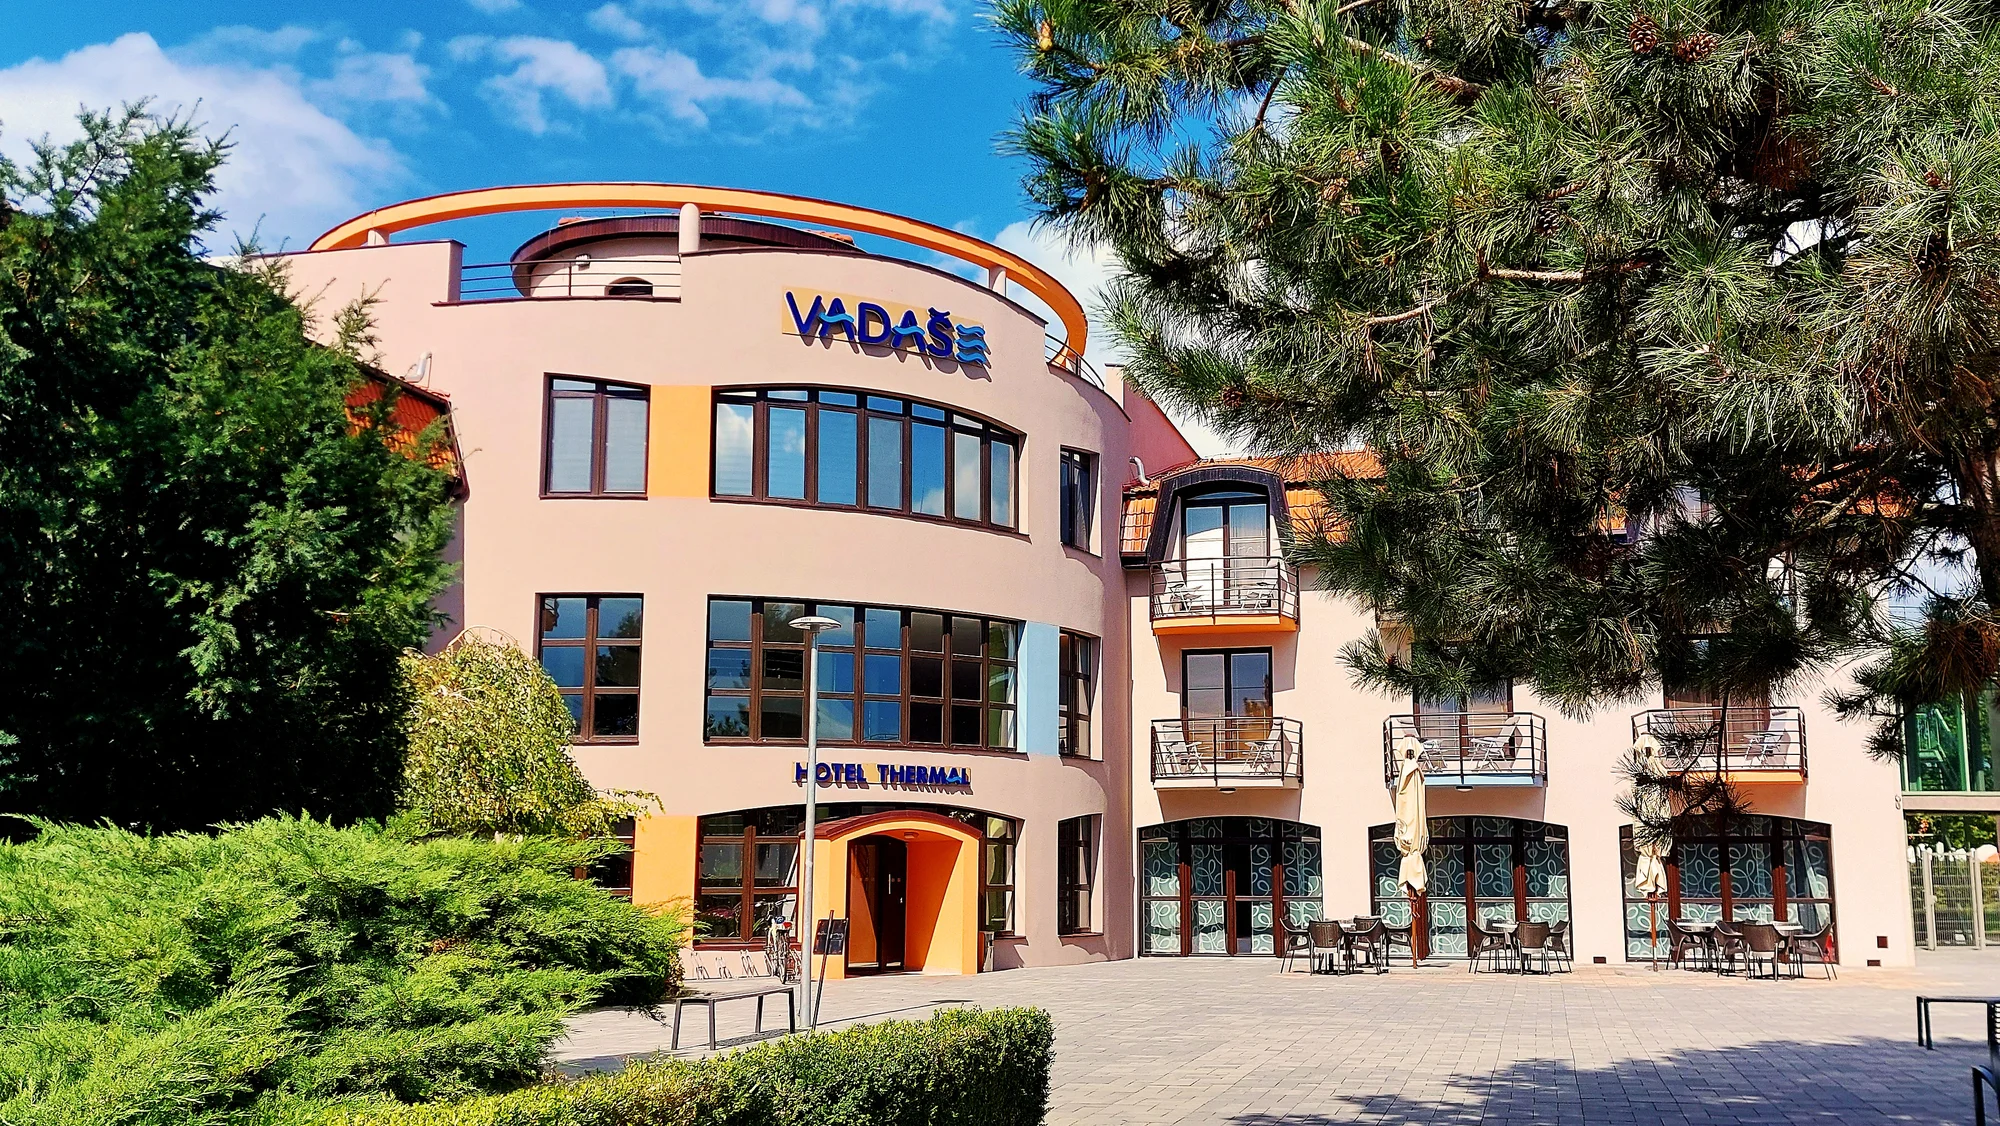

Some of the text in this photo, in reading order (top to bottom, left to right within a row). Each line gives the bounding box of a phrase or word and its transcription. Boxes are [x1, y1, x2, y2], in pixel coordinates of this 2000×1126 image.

[785, 291, 953, 358] VADAŠ
[795, 762, 970, 785] HOTEL THERMAL
